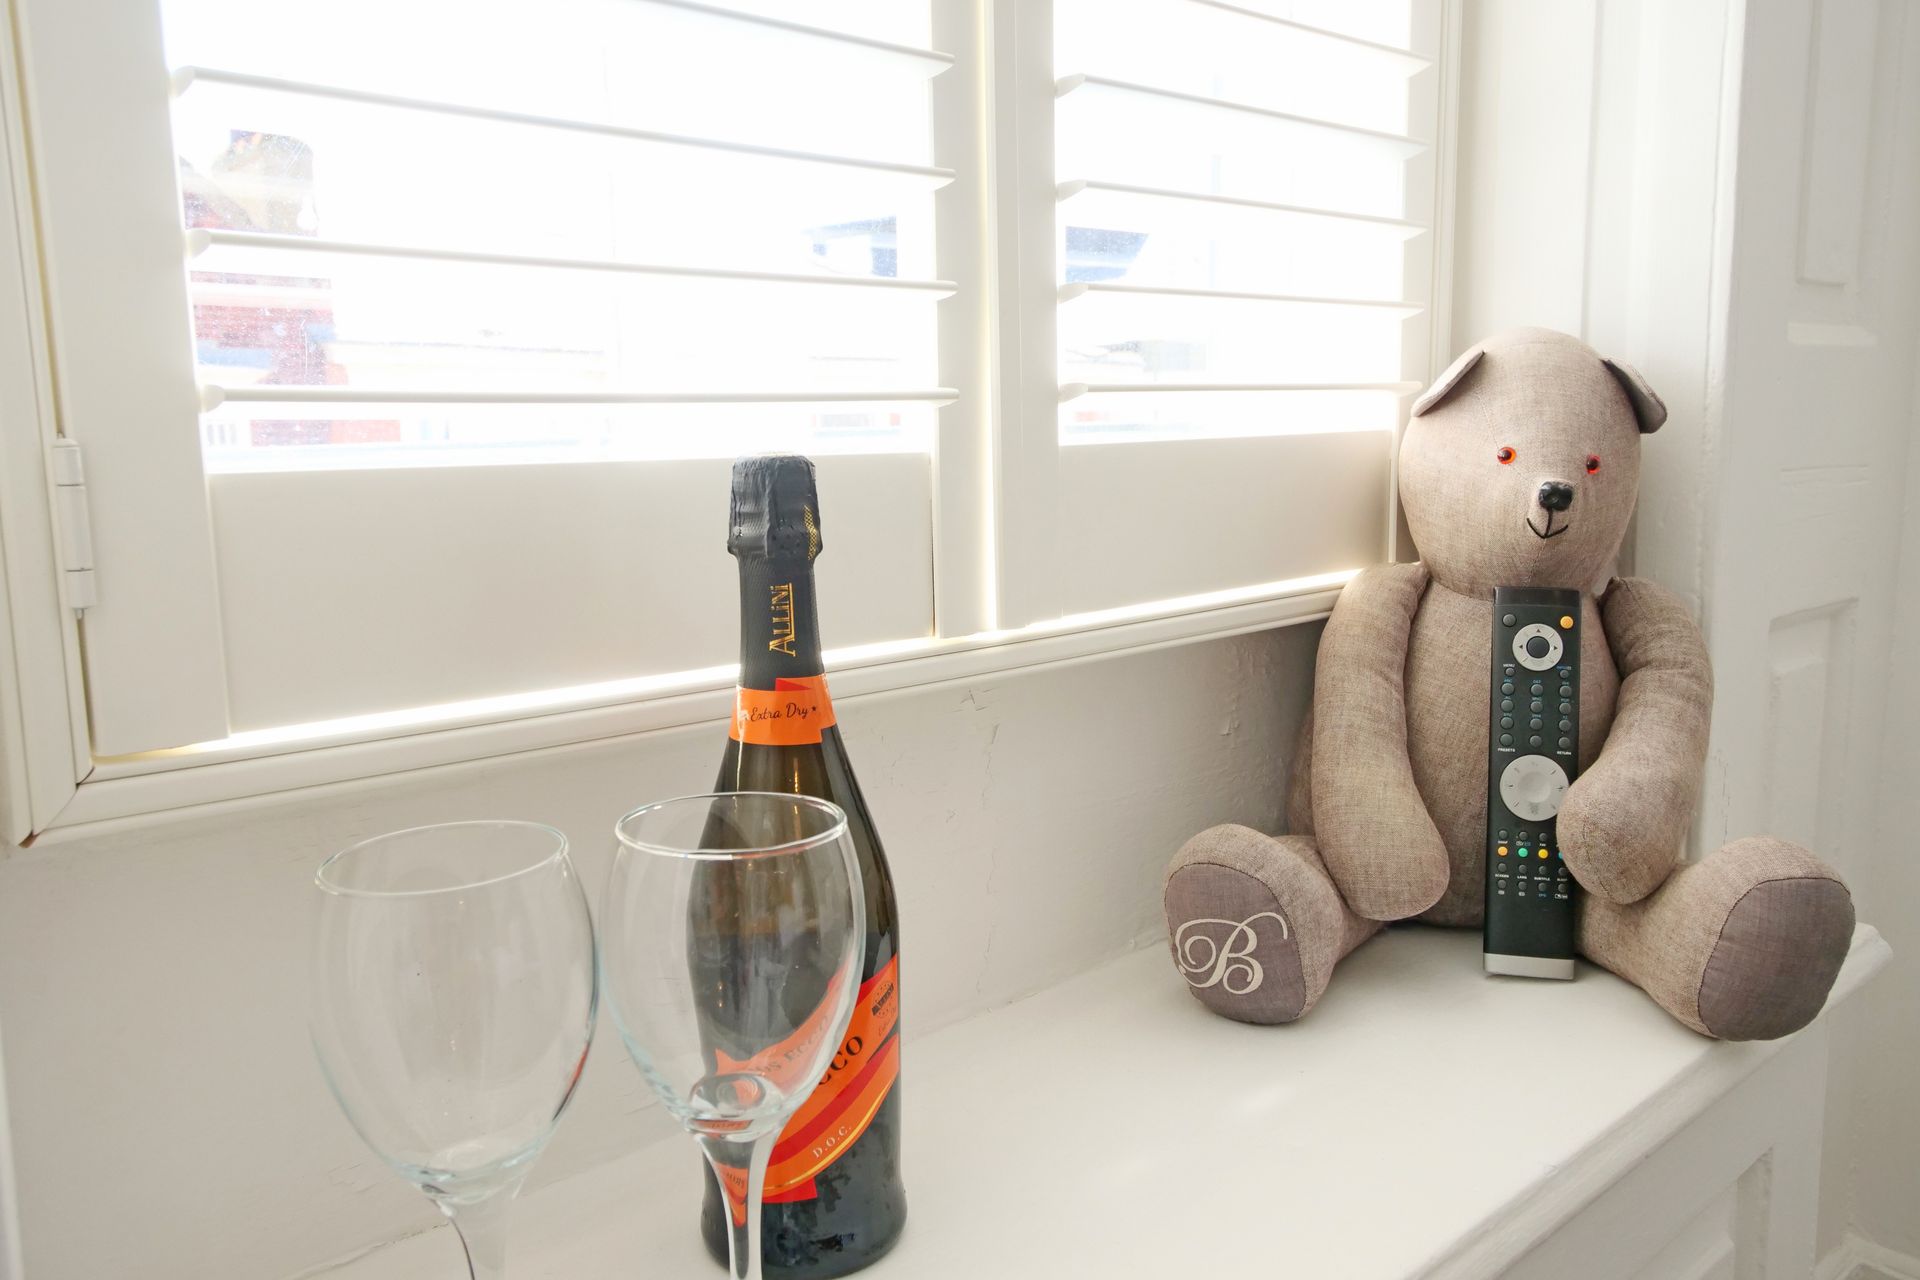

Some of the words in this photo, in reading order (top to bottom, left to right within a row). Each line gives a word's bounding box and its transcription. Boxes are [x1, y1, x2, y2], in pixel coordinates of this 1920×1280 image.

[751, 707, 781, 722] Extra
[786, 702, 808, 719] Dry
[1175, 912, 1287, 994] B
